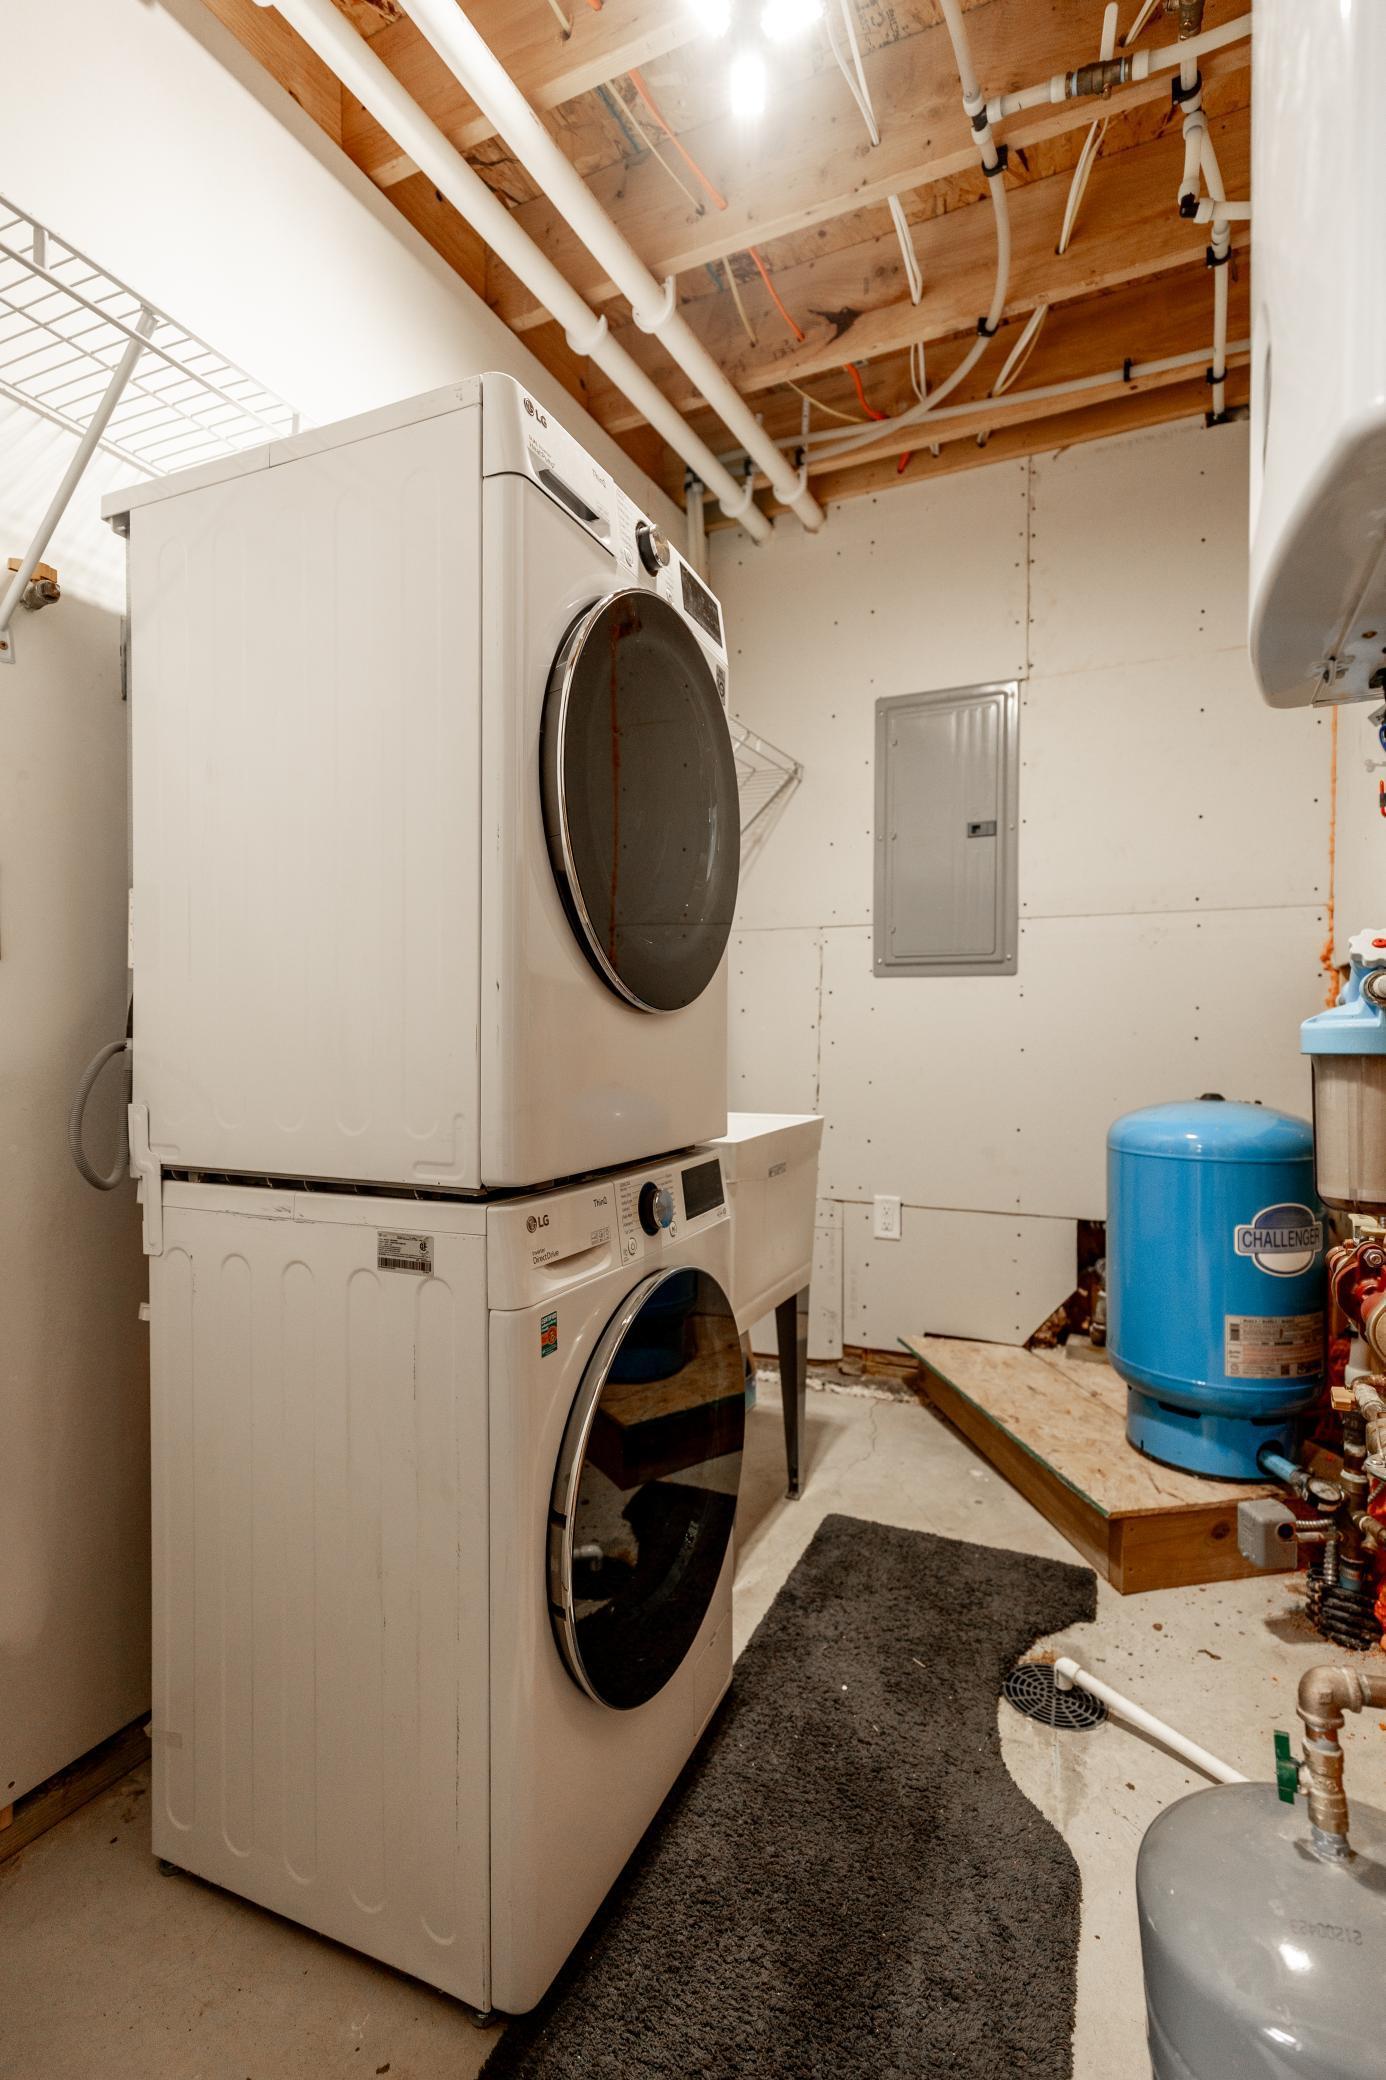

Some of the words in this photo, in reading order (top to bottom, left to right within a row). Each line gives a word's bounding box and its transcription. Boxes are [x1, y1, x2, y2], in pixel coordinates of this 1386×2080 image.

[535, 408, 548, 429] LG
[593, 1196, 608, 1208] ThinQ
[538, 1214, 550, 1228] LG
[1242, 1227, 1321, 1249] CHALLENGER
